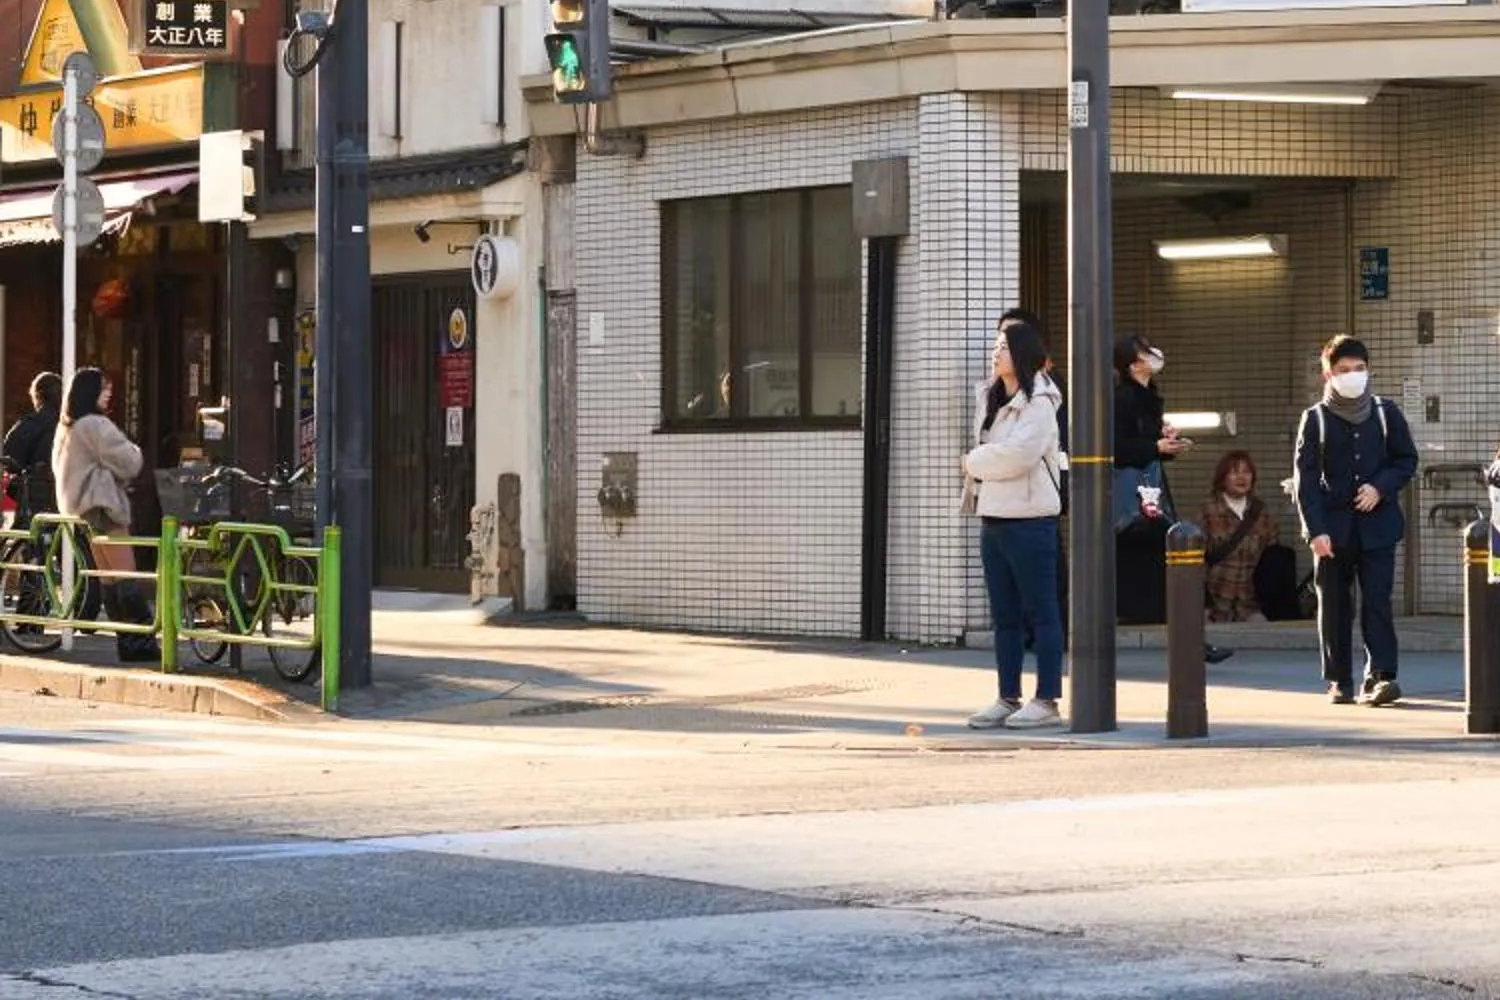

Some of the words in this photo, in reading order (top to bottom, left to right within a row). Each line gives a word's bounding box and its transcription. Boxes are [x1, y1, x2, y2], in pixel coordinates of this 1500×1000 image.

[155, 2, 213, 22] 創業
[149, 26, 224, 47] 大正八年
